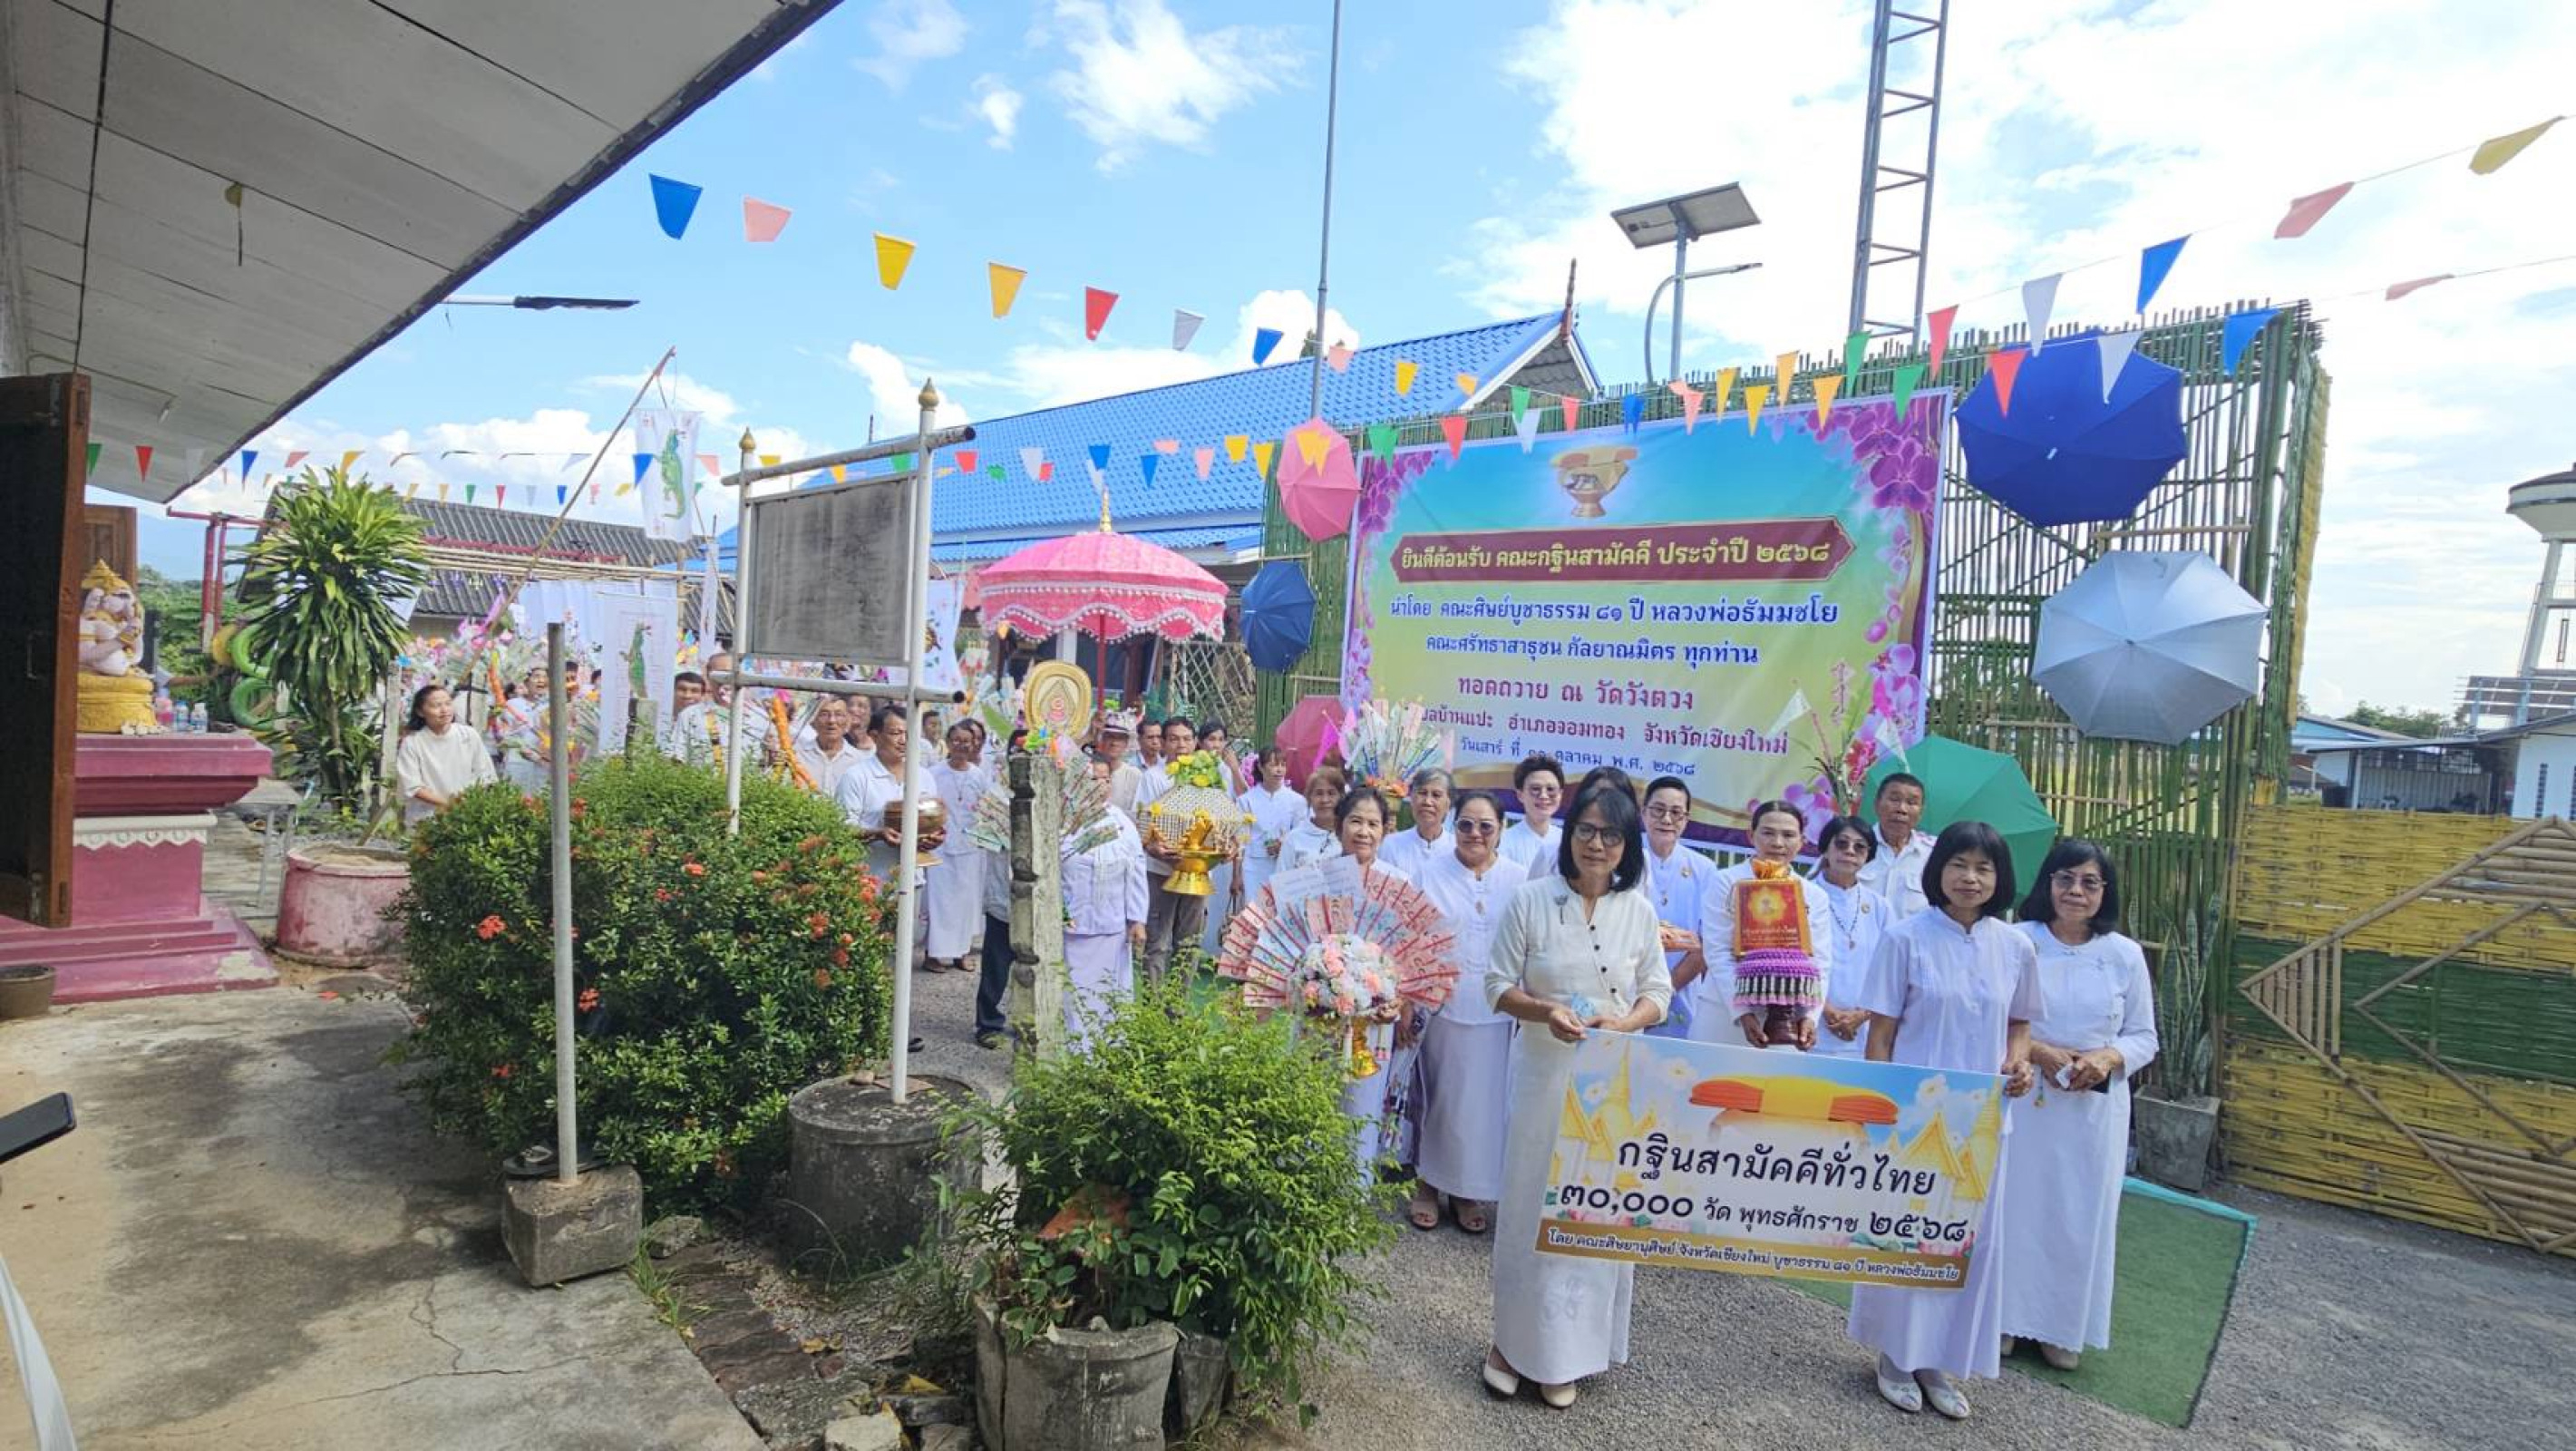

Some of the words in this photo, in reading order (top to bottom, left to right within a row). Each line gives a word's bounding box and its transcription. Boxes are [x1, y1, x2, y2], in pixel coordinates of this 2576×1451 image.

[1402, 545, 1491, 570] ยินดีต้อนรับ
[1496, 539, 1651, 574] คณะกฐินสามัคคี
[1657, 536, 1749, 565] ประจำปี
[1756, 542, 1831, 563] ๒๕๖๘
[1391, 593, 1432, 616] นำโดย
[1440, 594, 1590, 627] คณะศิษย์บูชาธรรม
[1596, 605, 1622, 622] ๘๑
[1628, 597, 1645, 621] ปี
[1651, 595, 1838, 623] หลวงพ่อธัมมชโย
[1426, 632, 1562, 662] คณะศรัทธาสาธุชน
[1568, 636, 1677, 661] กัลยาณมิตร
[1685, 640, 1758, 669] ทุกท่าน
[1458, 677, 1549, 699] ทอดถวาย
[1561, 684, 1584, 703] ณ
[1509, 713, 1625, 740] อำเภอจอมทอง
[1644, 722, 1789, 755] จังหวัดเชียงใหม่
[1462, 735, 1503, 755] วันเสาร์
[1510, 735, 1521, 757] ที่
[1612, 755, 1643, 772] พ.ศ.
[1652, 759, 1696, 775] ๒๕๖๘
[1619, 1132, 1936, 1195] กฐินสามัคคีทั่วไทย
[1560, 1183, 1694, 1217] ๓๐,๐๐๐
[1704, 1196, 1732, 1222] วัด
[1740, 1204, 1859, 1232] พุทธศักราช
[1870, 1211, 1969, 1242] ๒๕๖๘
[1549, 1227, 1574, 1245] โดย
[1577, 1235, 1677, 1257] คณะศิษยานุศิษย์
[1679, 1242, 1772, 1264] จังหวัดเชียงใหม่
[1774, 1255, 1831, 1271] บูชาธรรม
[1854, 1258, 1866, 1272] ปี
